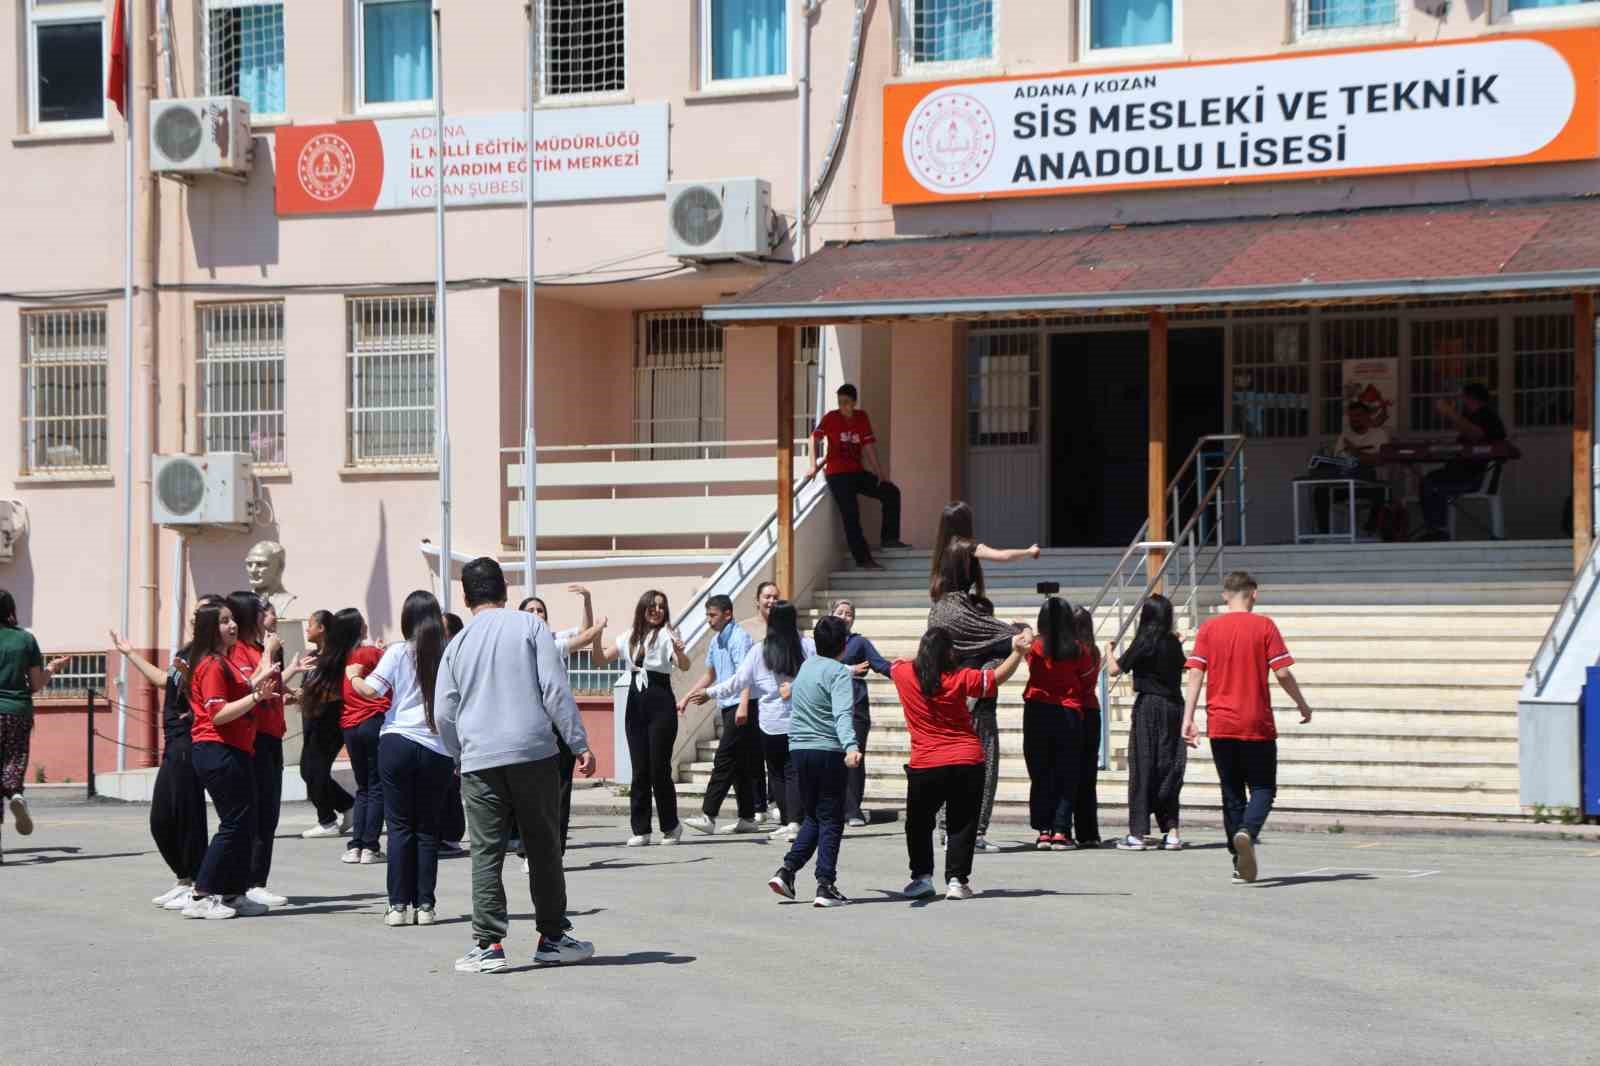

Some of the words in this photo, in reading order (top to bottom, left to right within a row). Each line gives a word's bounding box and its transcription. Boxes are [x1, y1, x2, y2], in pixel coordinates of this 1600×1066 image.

[1014, 83, 1077, 99] ADANA
[1081, 82, 1089, 98] /
[1094, 75, 1157, 95] KOZAN
[1013, 103, 1077, 140] SİS
[1089, 85, 1264, 135] MESLEKİ
[1277, 90, 1328, 121] VE
[1339, 69, 1500, 115] TEKNİK
[410, 125, 465, 139] ADNA
[410, 142, 423, 160] İL
[475, 135, 528, 156] EĞİTİM
[535, 130, 640, 152] MÜDÜRLÜĞÜ
[410, 162, 434, 179] İLK
[508, 155, 561, 174] EĞTİM
[568, 149, 640, 171] MERKEZİ
[1011, 142, 1203, 183] ANADOLU
[1216, 125, 1347, 170] LİSESİ
[411, 182, 464, 200] KOAN
